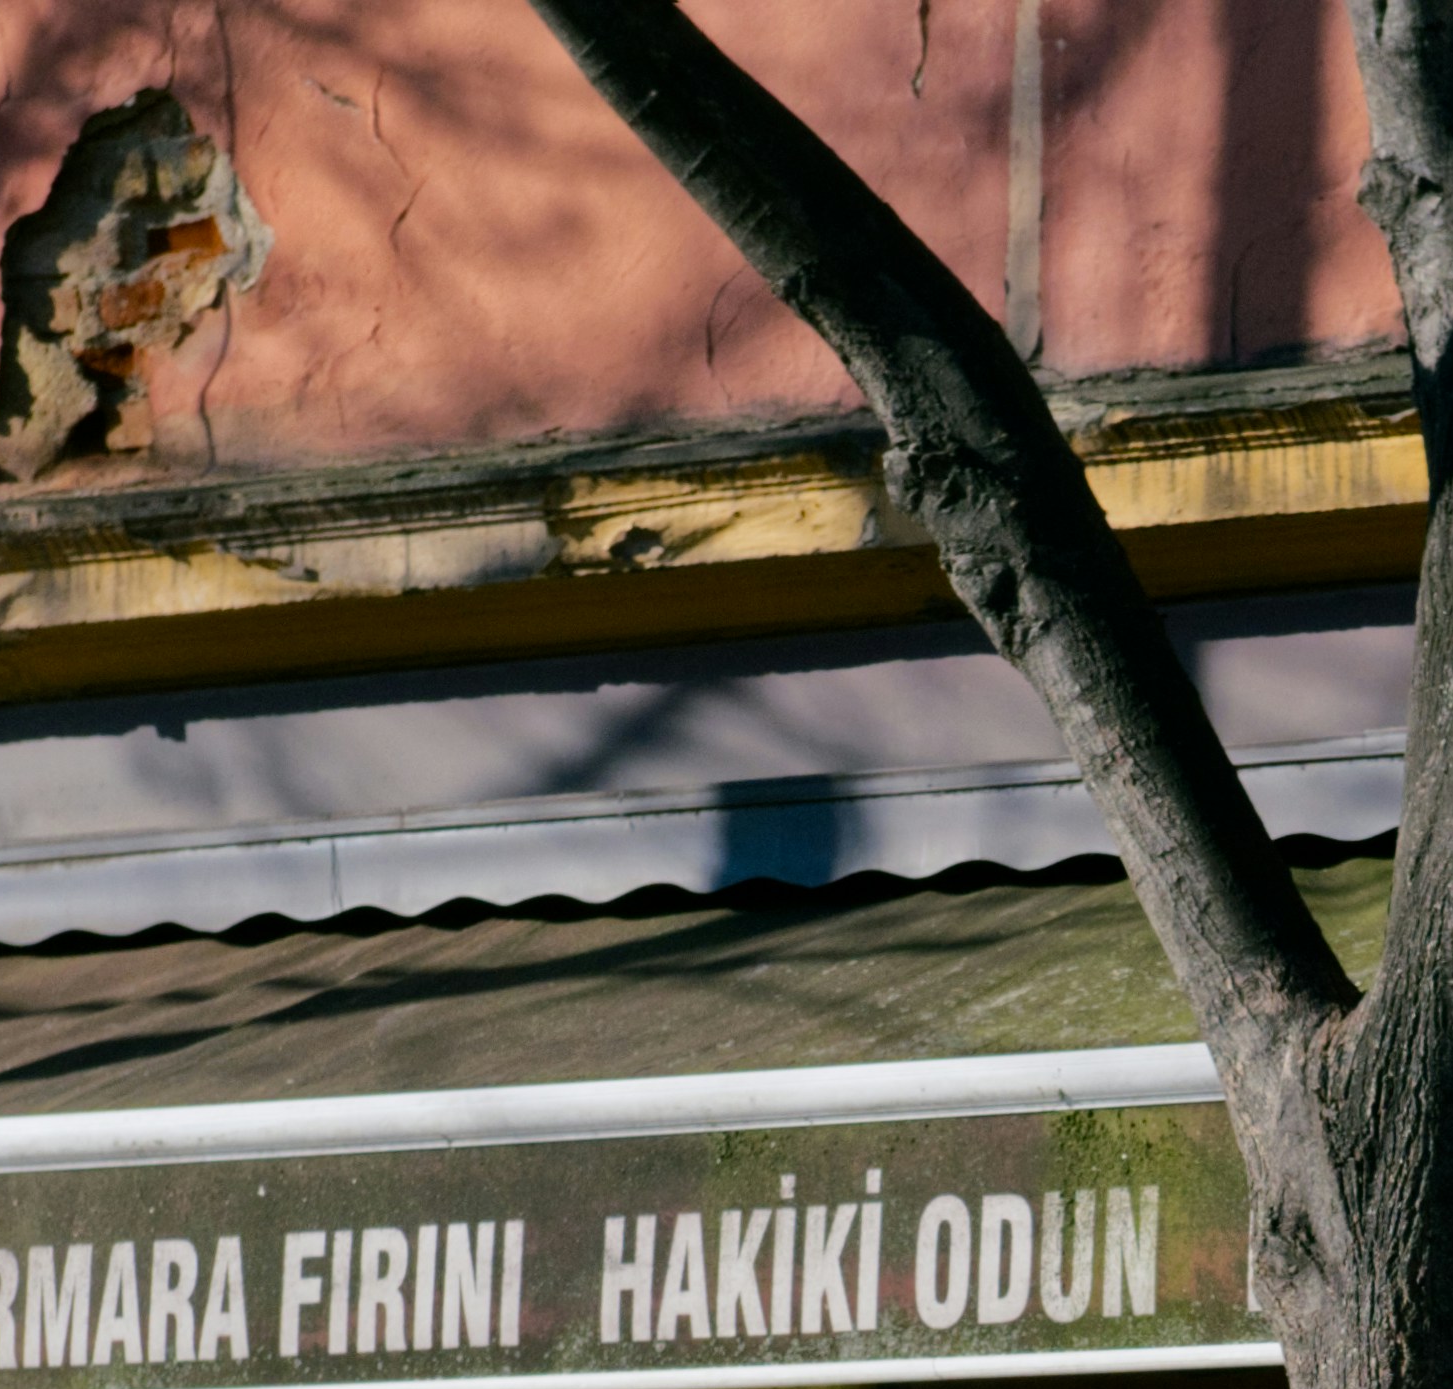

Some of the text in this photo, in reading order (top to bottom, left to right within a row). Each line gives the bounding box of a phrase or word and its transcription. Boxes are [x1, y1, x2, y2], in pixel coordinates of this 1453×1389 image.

[279, 1219, 525, 1357] FIRINI
[600, 1168, 883, 1344] HAKİKİ
[914, 1186, 1160, 1330] ODUN
